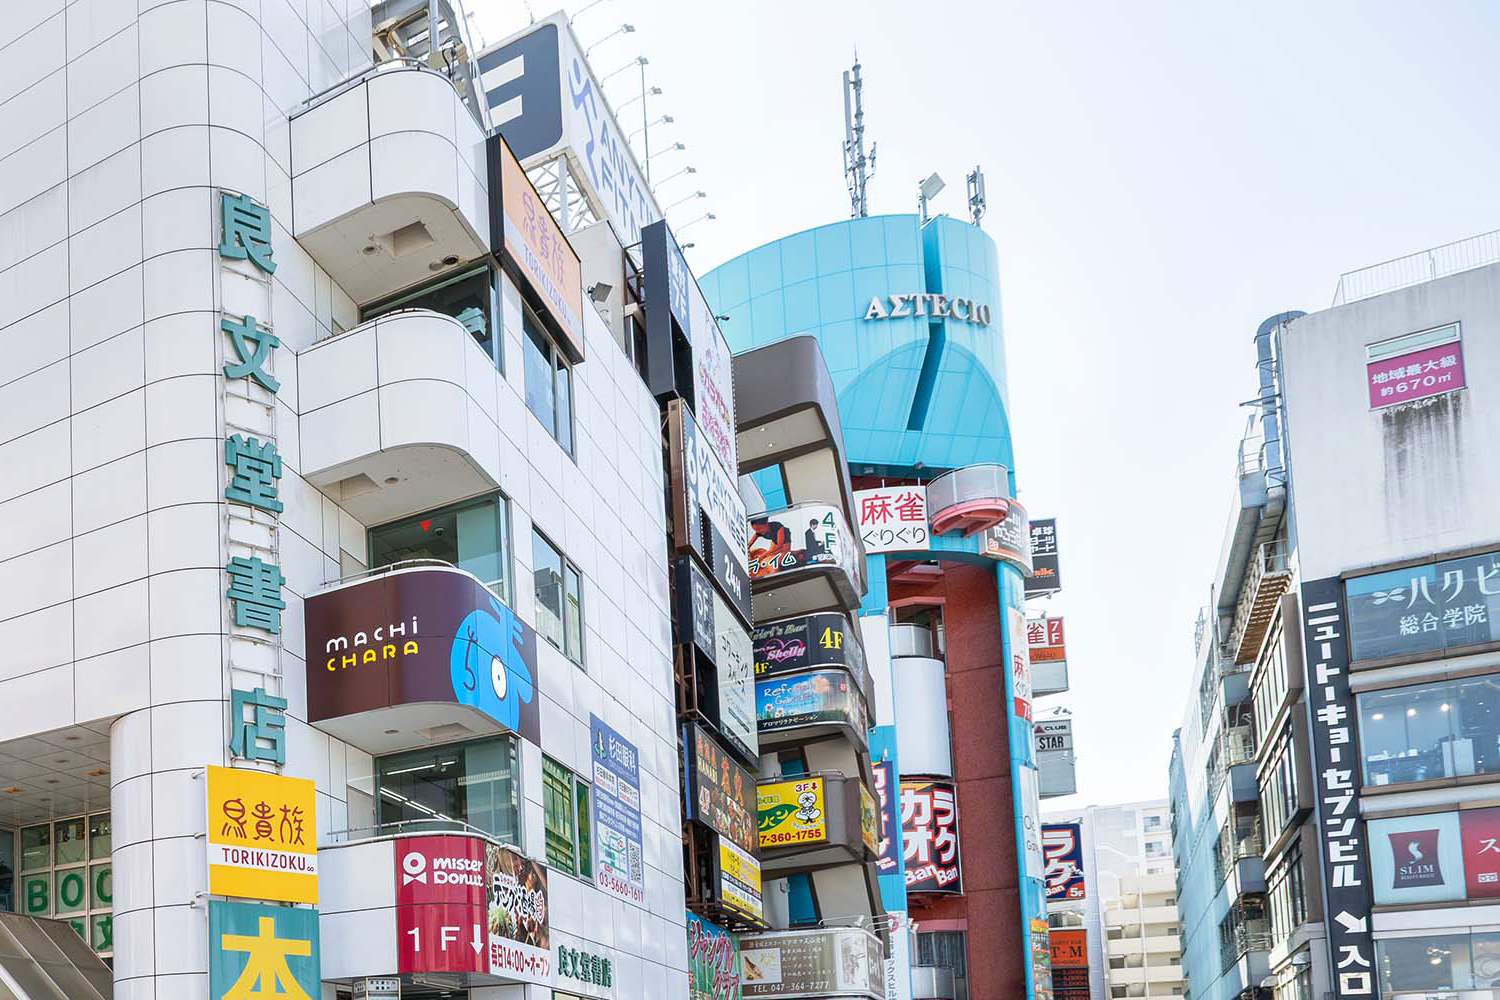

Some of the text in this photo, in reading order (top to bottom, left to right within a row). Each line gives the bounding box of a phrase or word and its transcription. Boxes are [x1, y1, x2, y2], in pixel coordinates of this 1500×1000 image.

[1372, 355, 1457, 384] 地域最大級
[218, 193, 288, 766] 良文堂書店
[861, 493, 926, 527] 麻雀
[822, 511, 837, 550] 4F
[862, 526, 926, 547] ぐりぐり
[1027, 622, 1045, 644] 雀
[1399, 604, 1487, 636] 総合学院
[819, 627, 844, 650] 4F
[327, 640, 419, 672] CHARA
[766, 645, 807, 662] Shelly
[1038, 736, 1064, 749] STAR
[1308, 602, 1361, 888] ニュートーキョーセブンビル
[795, 783, 810, 792] 3F
[221, 798, 305, 846] 鳥貴族
[760, 829, 822, 844] 7-360-1755
[1043, 830, 1074, 857] ラ
[222, 847, 307, 872] TORIKIZOKU
[1044, 858, 1077, 887] ケ
[1399, 864, 1435, 875] SLIM
[433, 870, 485, 887] Donut
[938, 866, 958, 885] Ban
[27, 869, 112, 912] BOO
[1069, 886, 1085, 897] 5F
[558, 944, 612, 988] 良文堂書店
[1337, 945, 1372, 996] 入口
[753, 985, 768, 993] TEL
